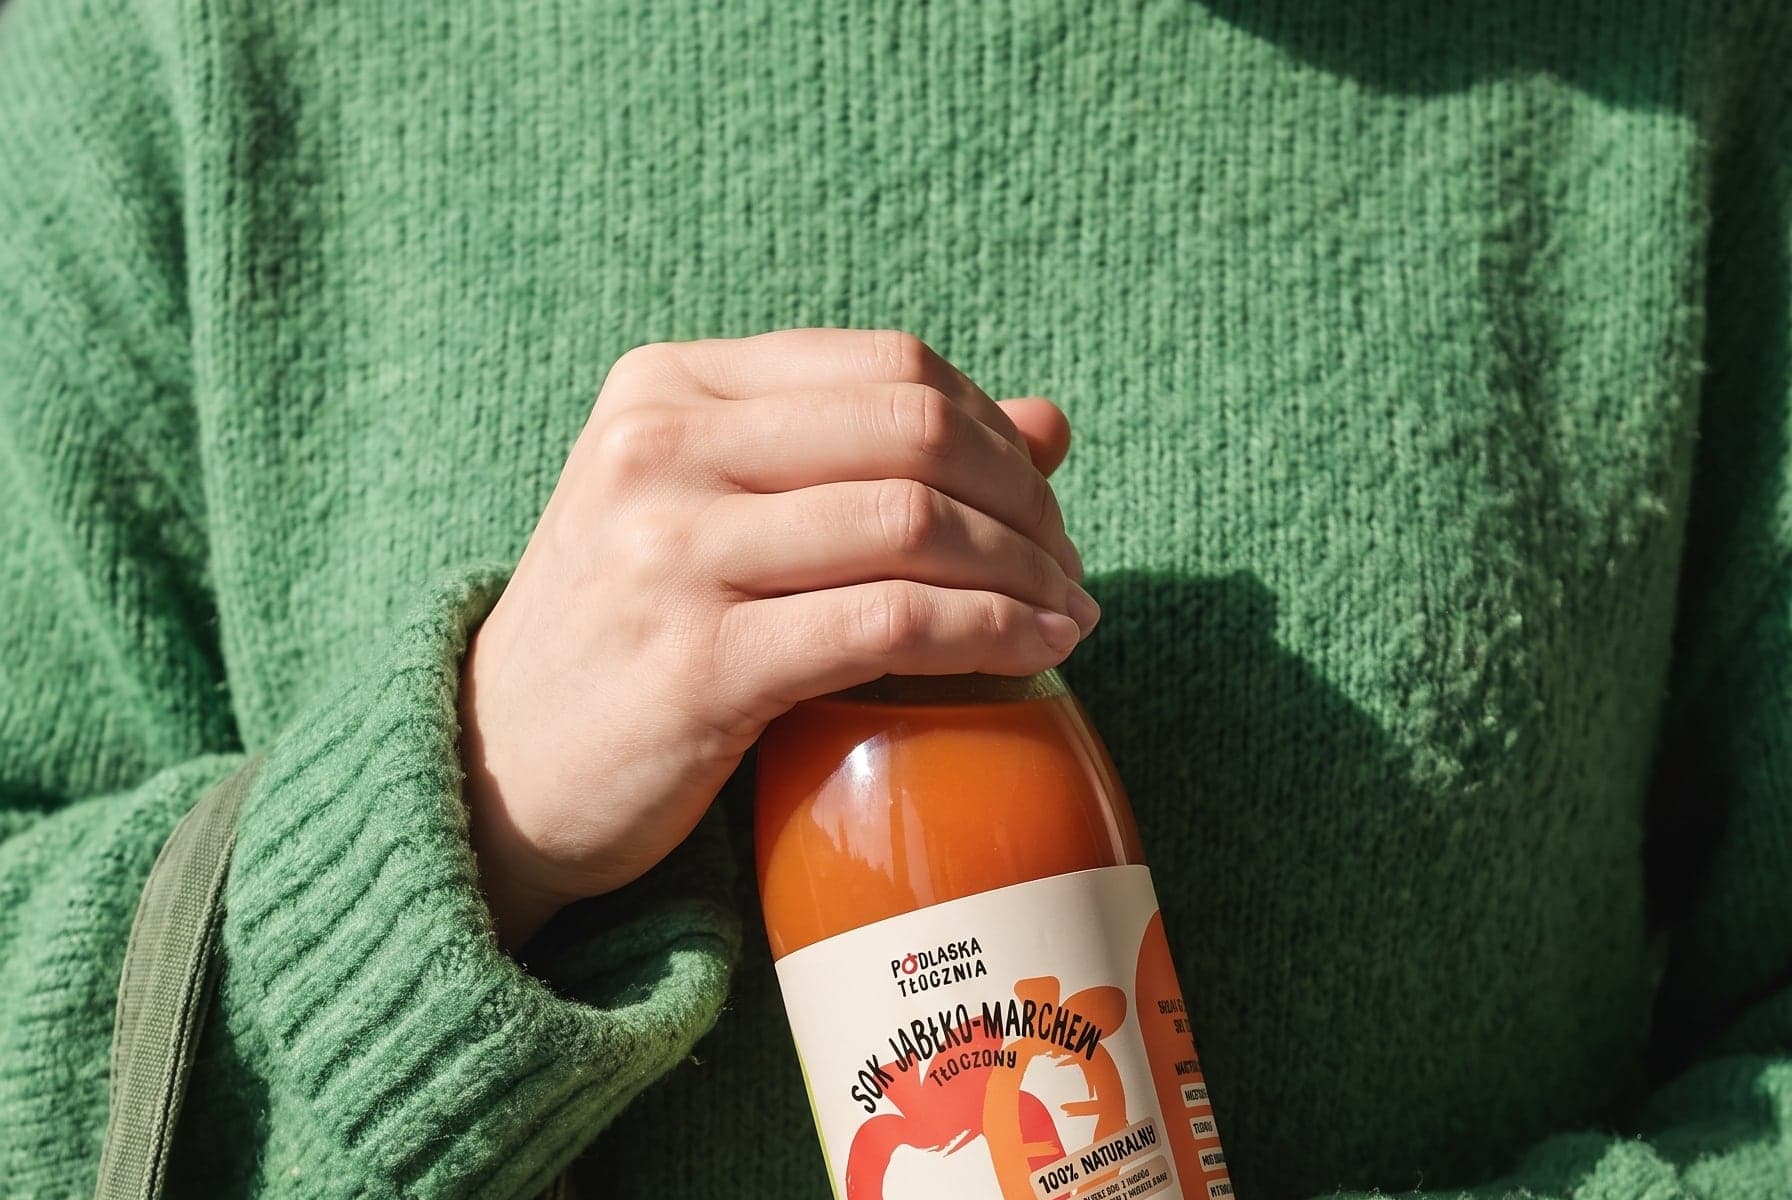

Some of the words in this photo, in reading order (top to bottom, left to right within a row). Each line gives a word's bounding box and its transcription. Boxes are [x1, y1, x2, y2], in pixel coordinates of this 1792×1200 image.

[891, 937, 982, 978] PODLASKA
[898, 959, 987, 997] TŁOCZNIA
[851, 1054, 894, 1114] SOK
[889, 999, 1102, 1072] JABŁKO-MARCHEW
[929, 1049, 1017, 1087] TŁOCZONY
[1038, 1163, 1079, 1194] 100%
